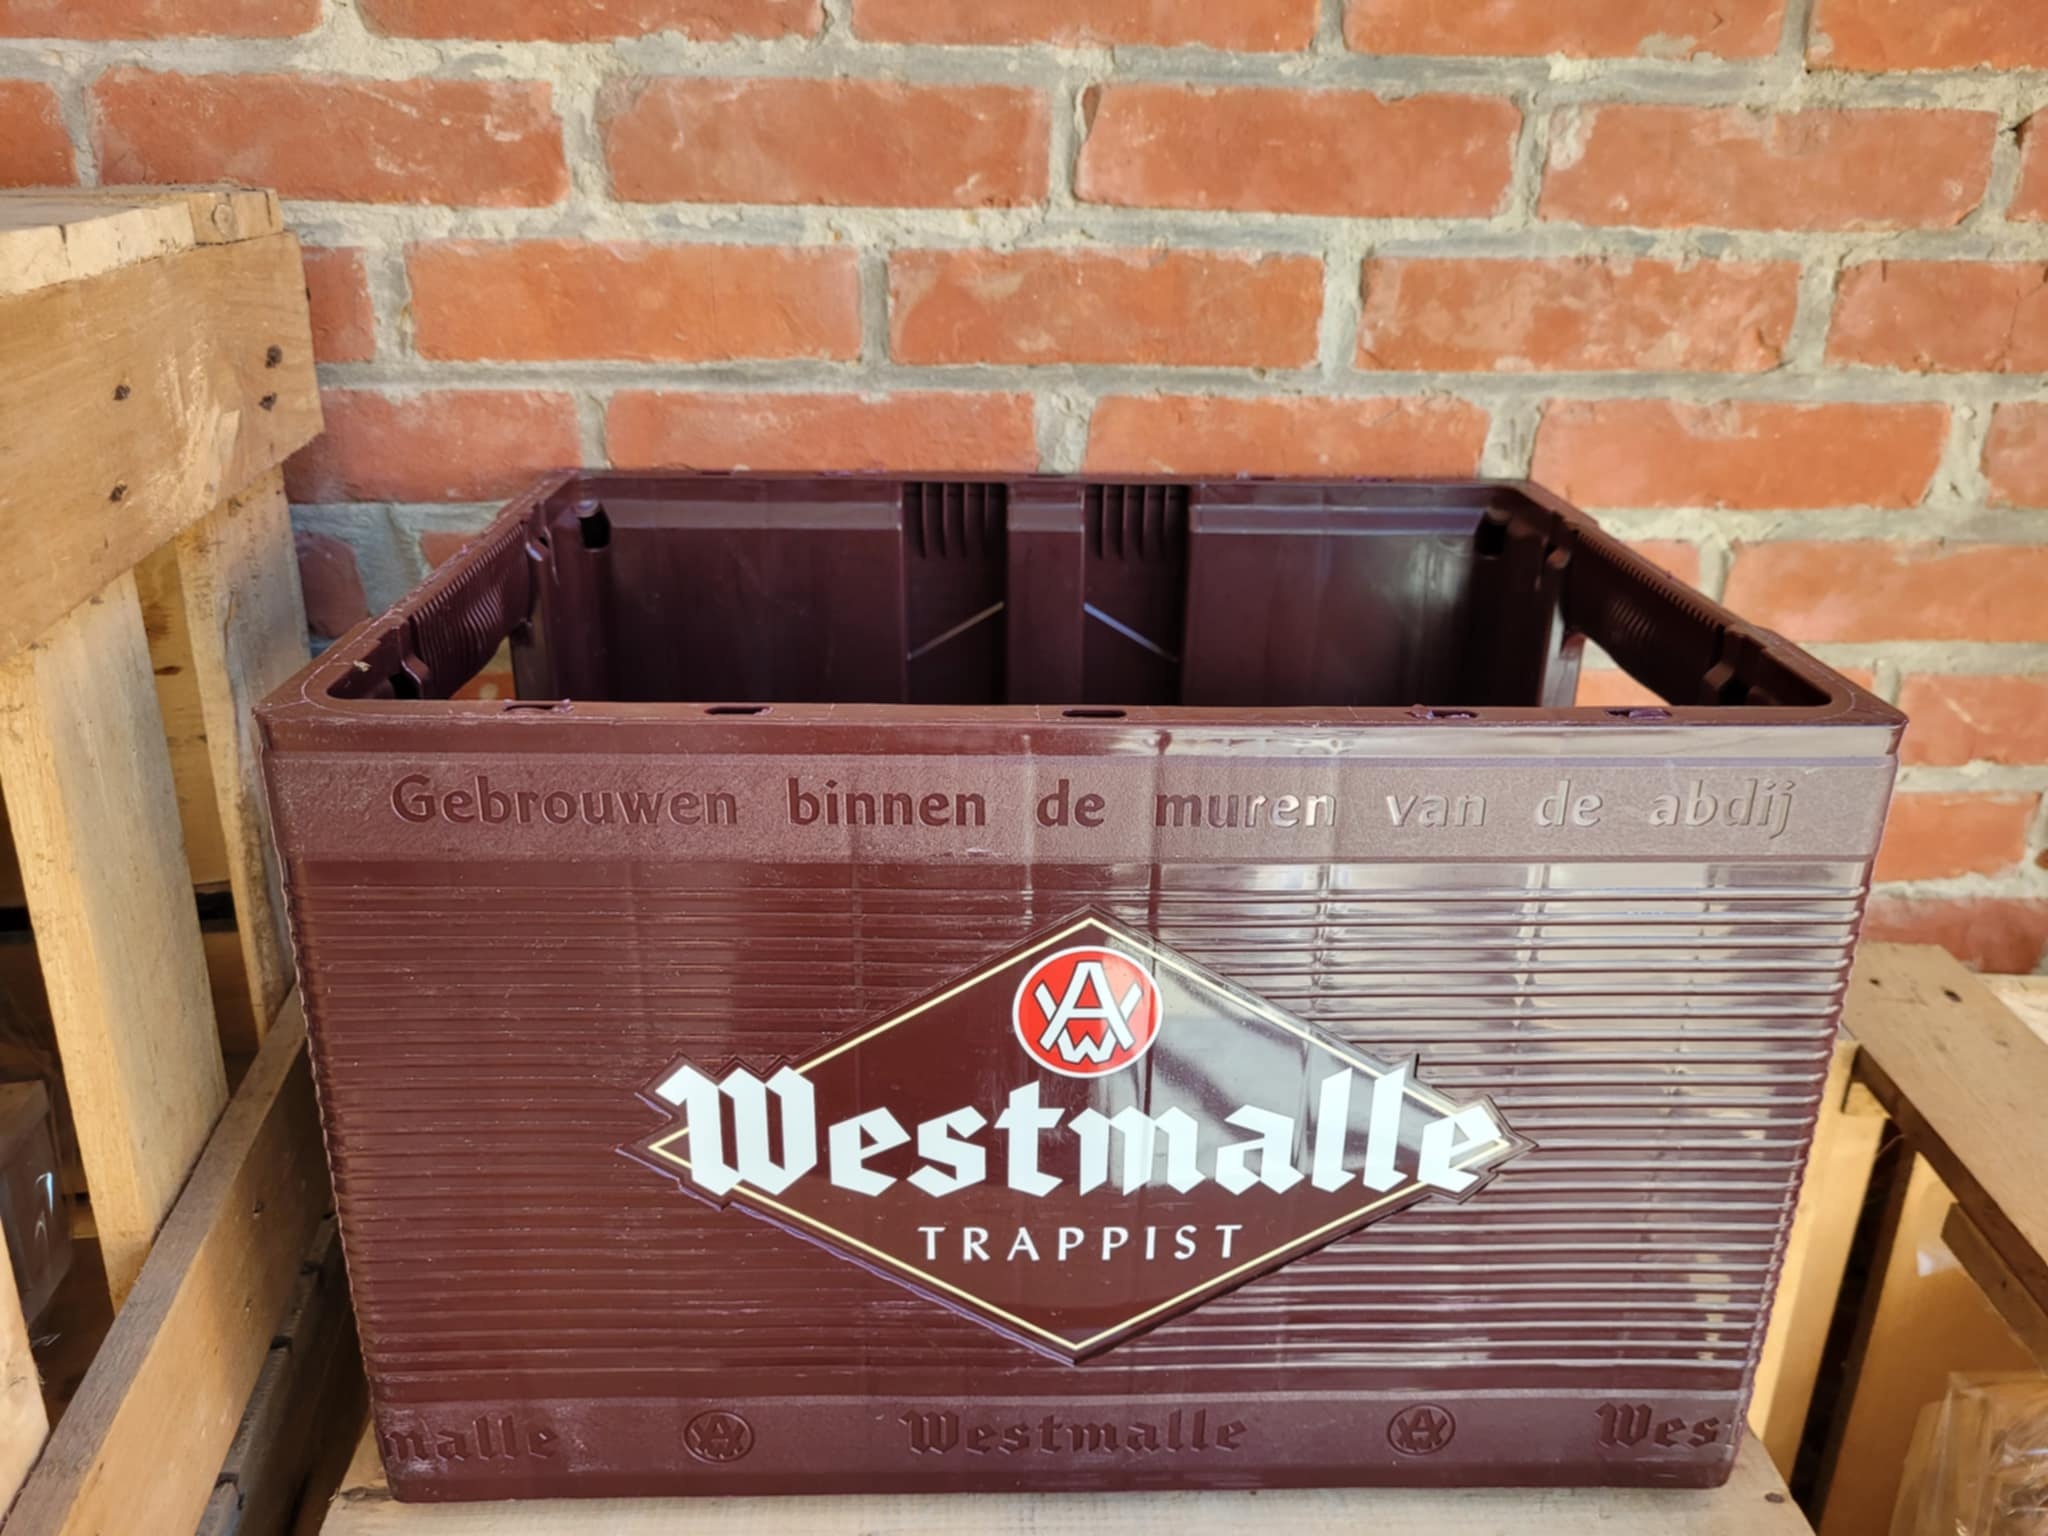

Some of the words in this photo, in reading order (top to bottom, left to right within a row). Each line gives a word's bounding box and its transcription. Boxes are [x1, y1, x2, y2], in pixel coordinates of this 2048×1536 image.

[391, 774, 738, 825] Gebrouwen
[787, 778, 986, 827] binnen
[1037, 779, 1104, 827] de
[1155, 790, 1337, 828] muren
[1386, 792, 1488, 828] van
[1535, 780, 1604, 829] de
[1648, 778, 1797, 838] abdij
[656, 1063, 1502, 1197] Westmalle
[918, 1224, 1243, 1263] TRAPPIST
[899, 1408, 1248, 1456] Westmalle
